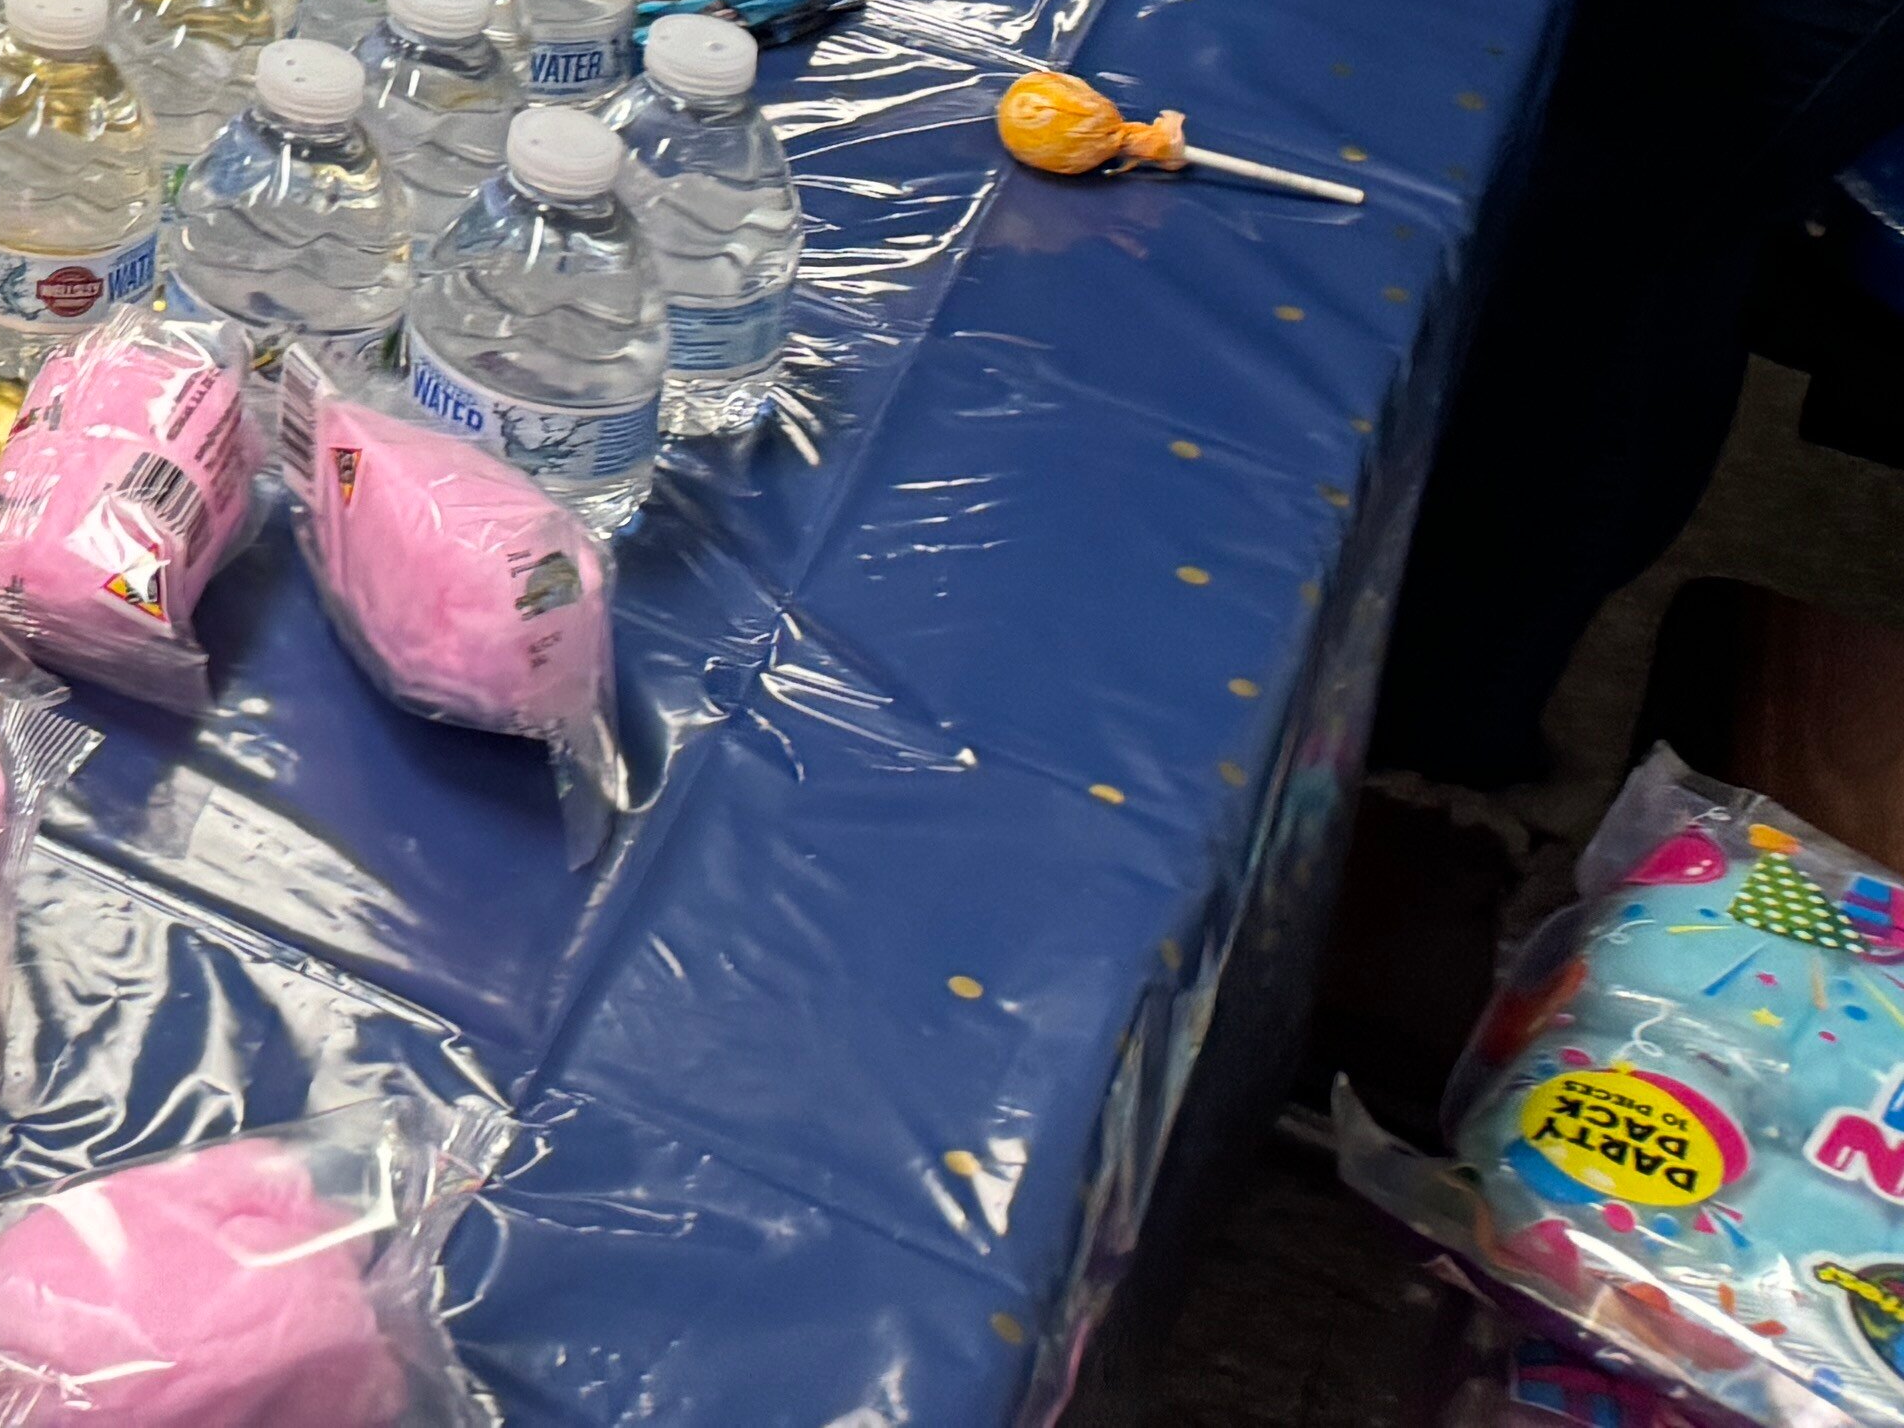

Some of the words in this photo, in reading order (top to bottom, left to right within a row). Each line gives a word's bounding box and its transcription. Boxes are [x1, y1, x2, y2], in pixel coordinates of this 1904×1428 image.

[1551, 1095, 1689, 1161] PACK
[1563, 1080, 1653, 1116] PIECES
[1531, 1116, 1699, 1194] PARTY
